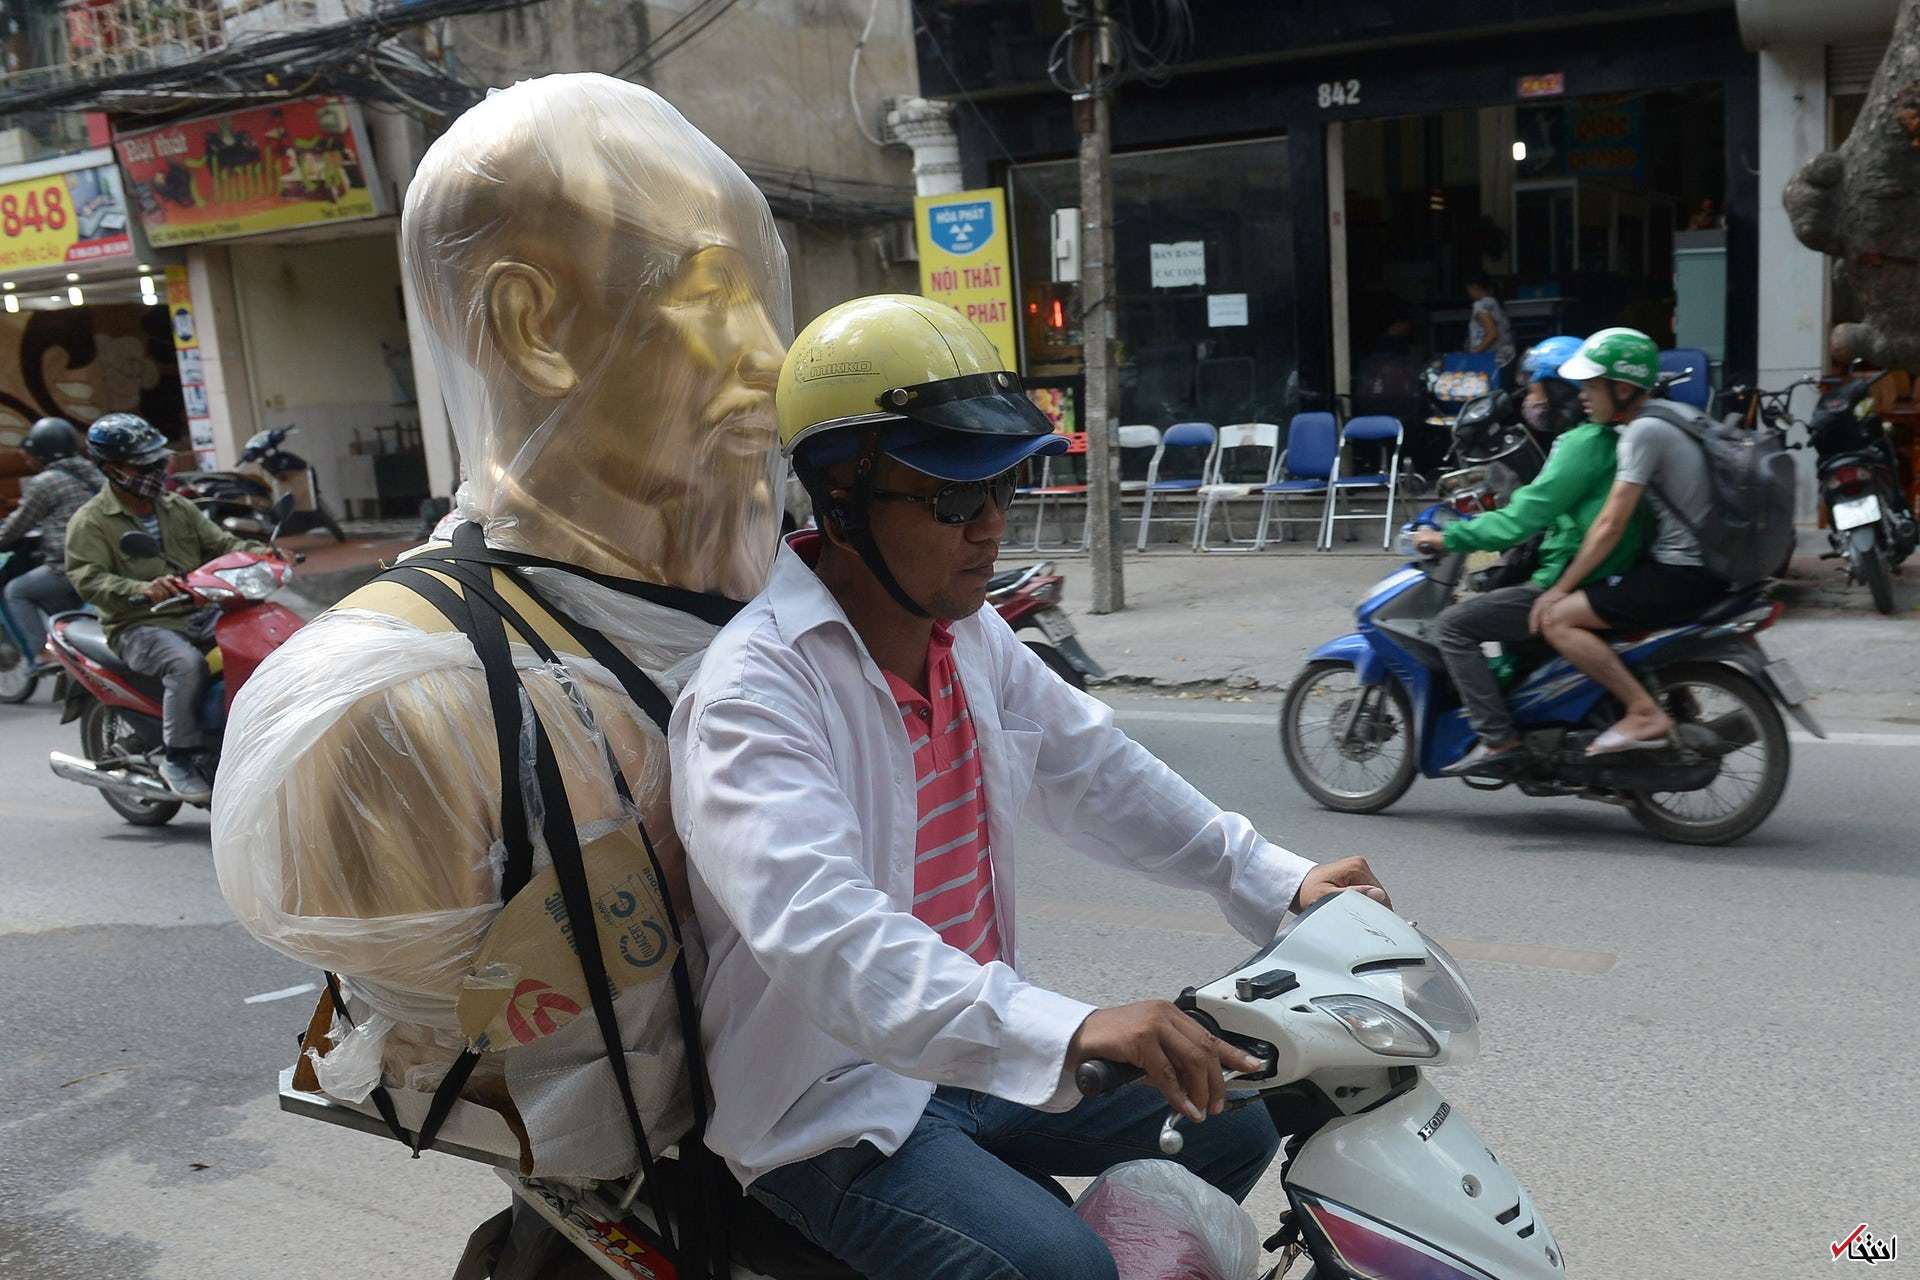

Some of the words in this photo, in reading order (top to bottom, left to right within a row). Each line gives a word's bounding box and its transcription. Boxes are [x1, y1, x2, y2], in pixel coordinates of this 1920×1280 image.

[1318, 79, 1360, 108] 842
[1, 186, 67, 237] 848
[931, 265, 958, 295] NỘI
[963, 259, 1001, 289] THẤT
[967, 298, 1007, 324] PHÁT
